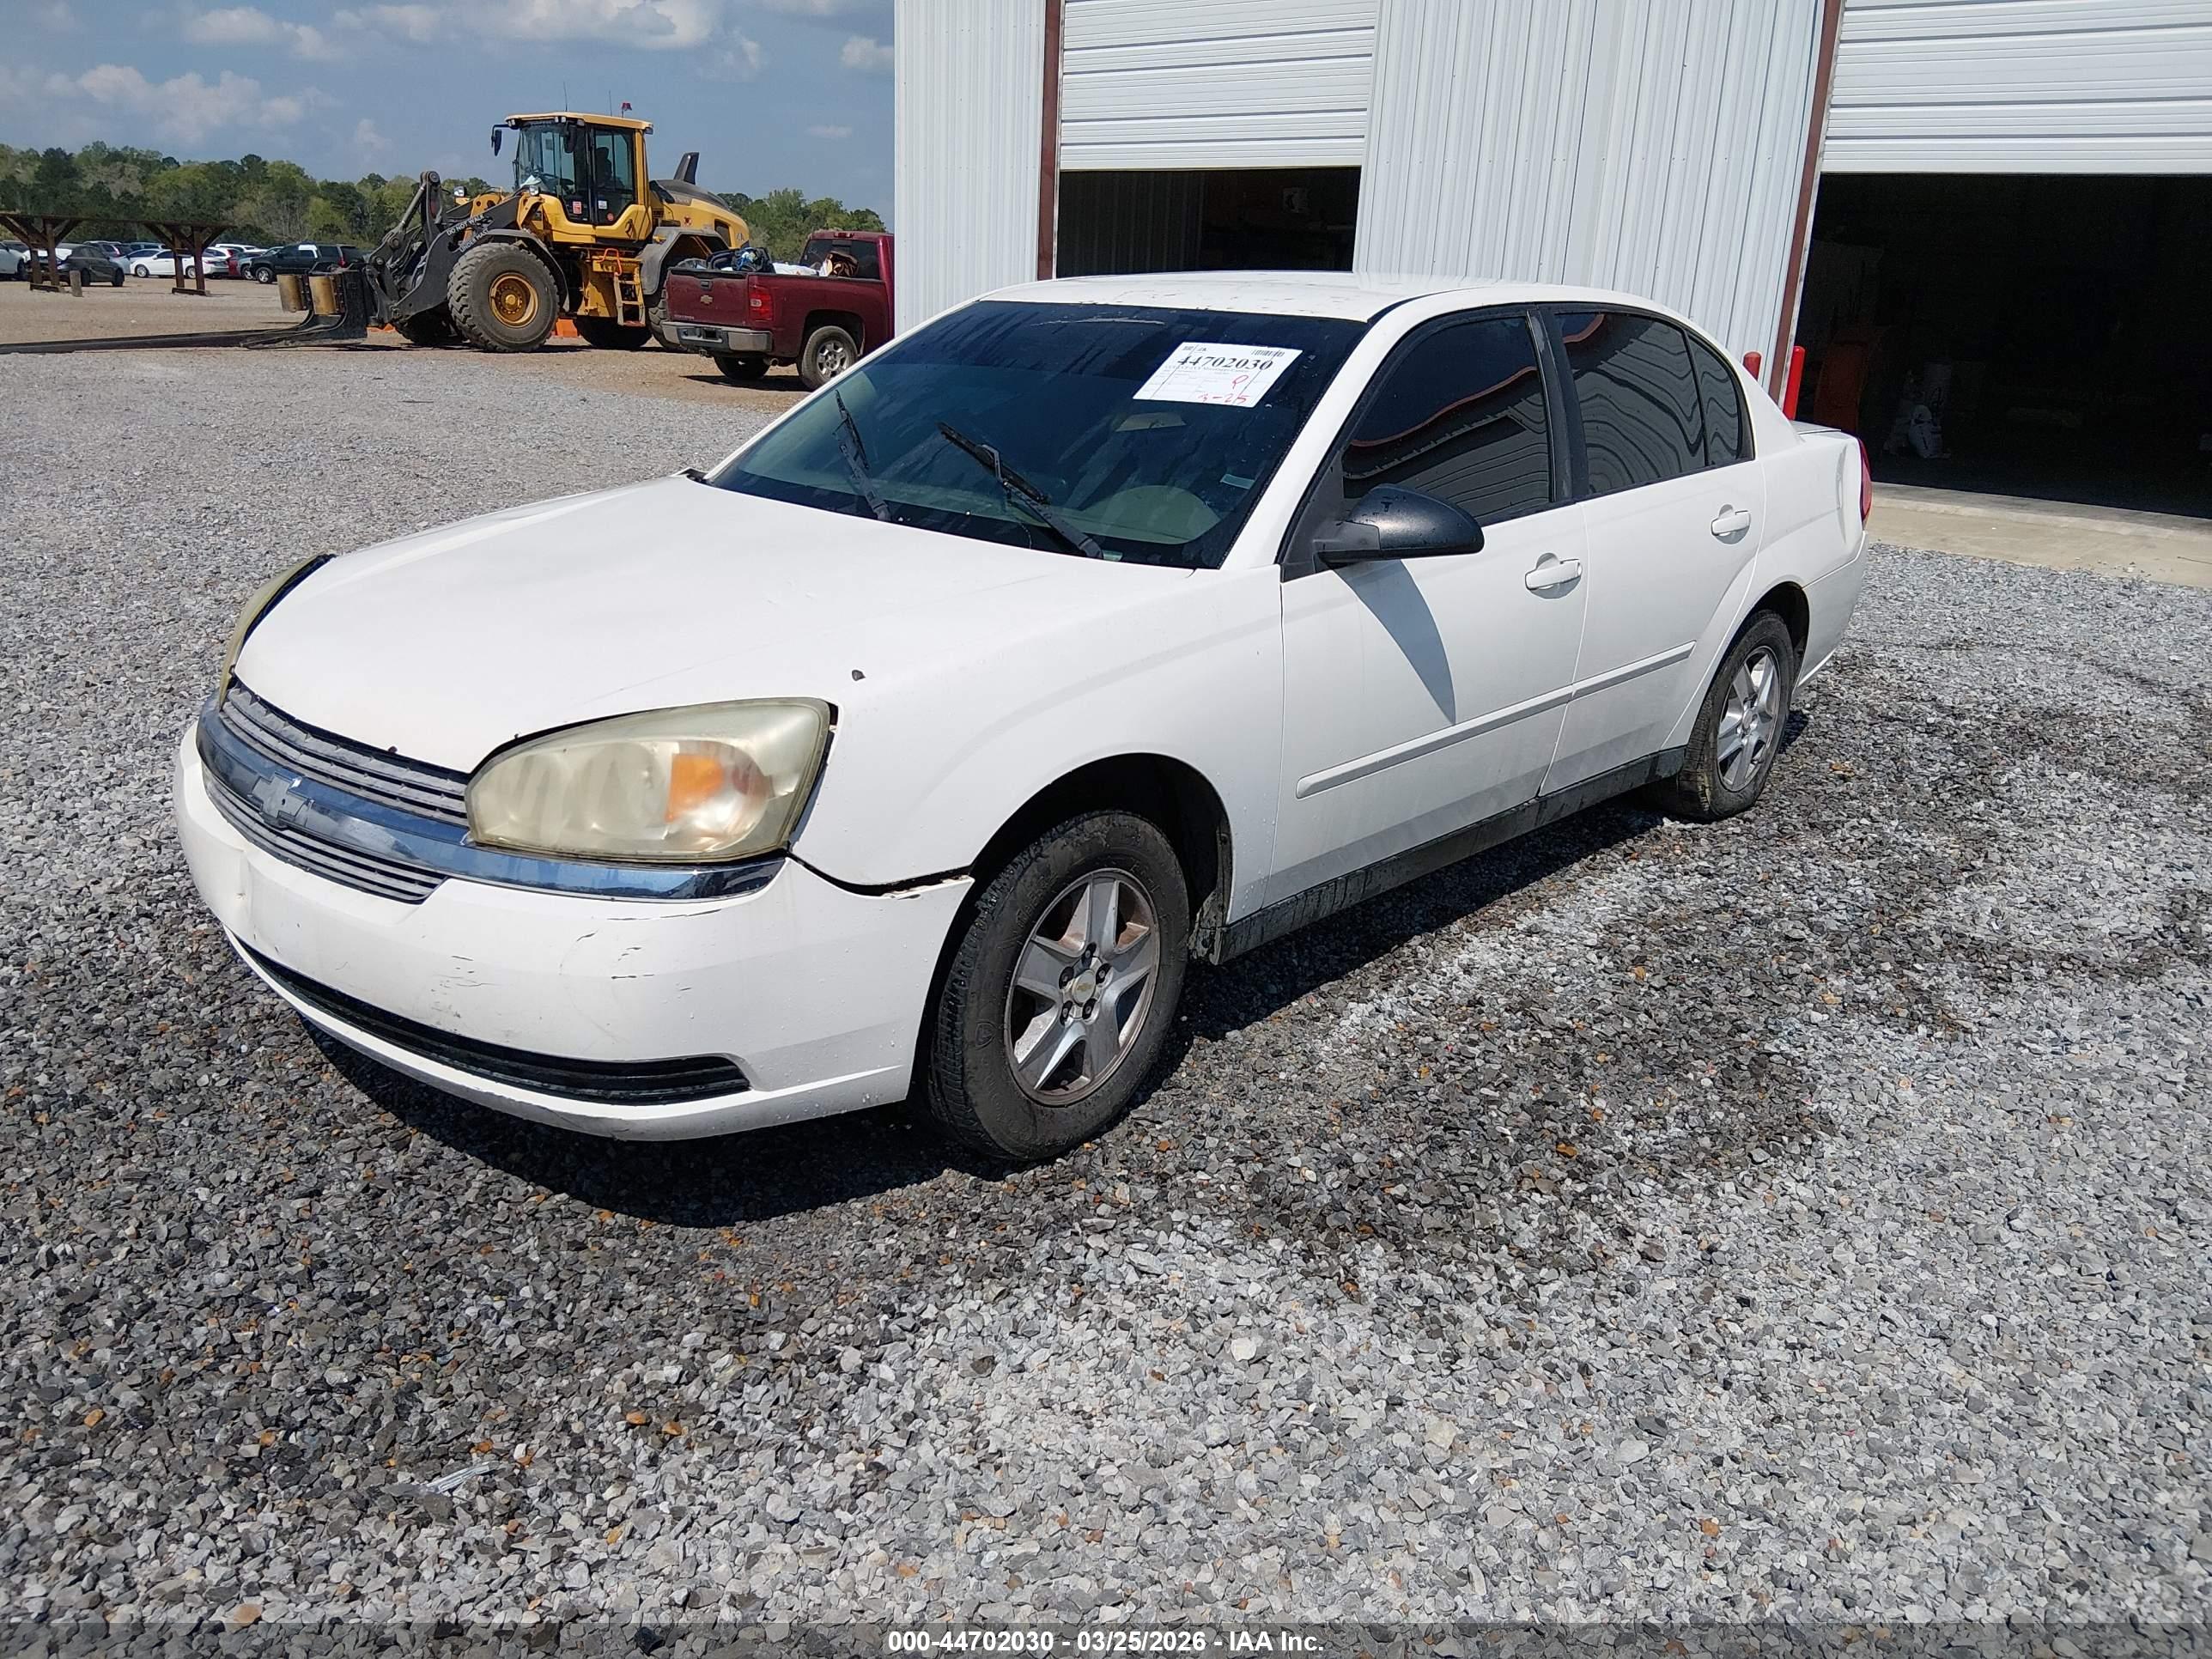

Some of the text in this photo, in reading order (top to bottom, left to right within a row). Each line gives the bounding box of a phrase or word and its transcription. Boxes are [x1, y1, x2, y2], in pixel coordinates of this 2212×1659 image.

[447, 214, 485, 236] DO NOT WALK
[459, 227, 489, 252] UNDER MAST
[1177, 355, 1273, 371] 44702030
